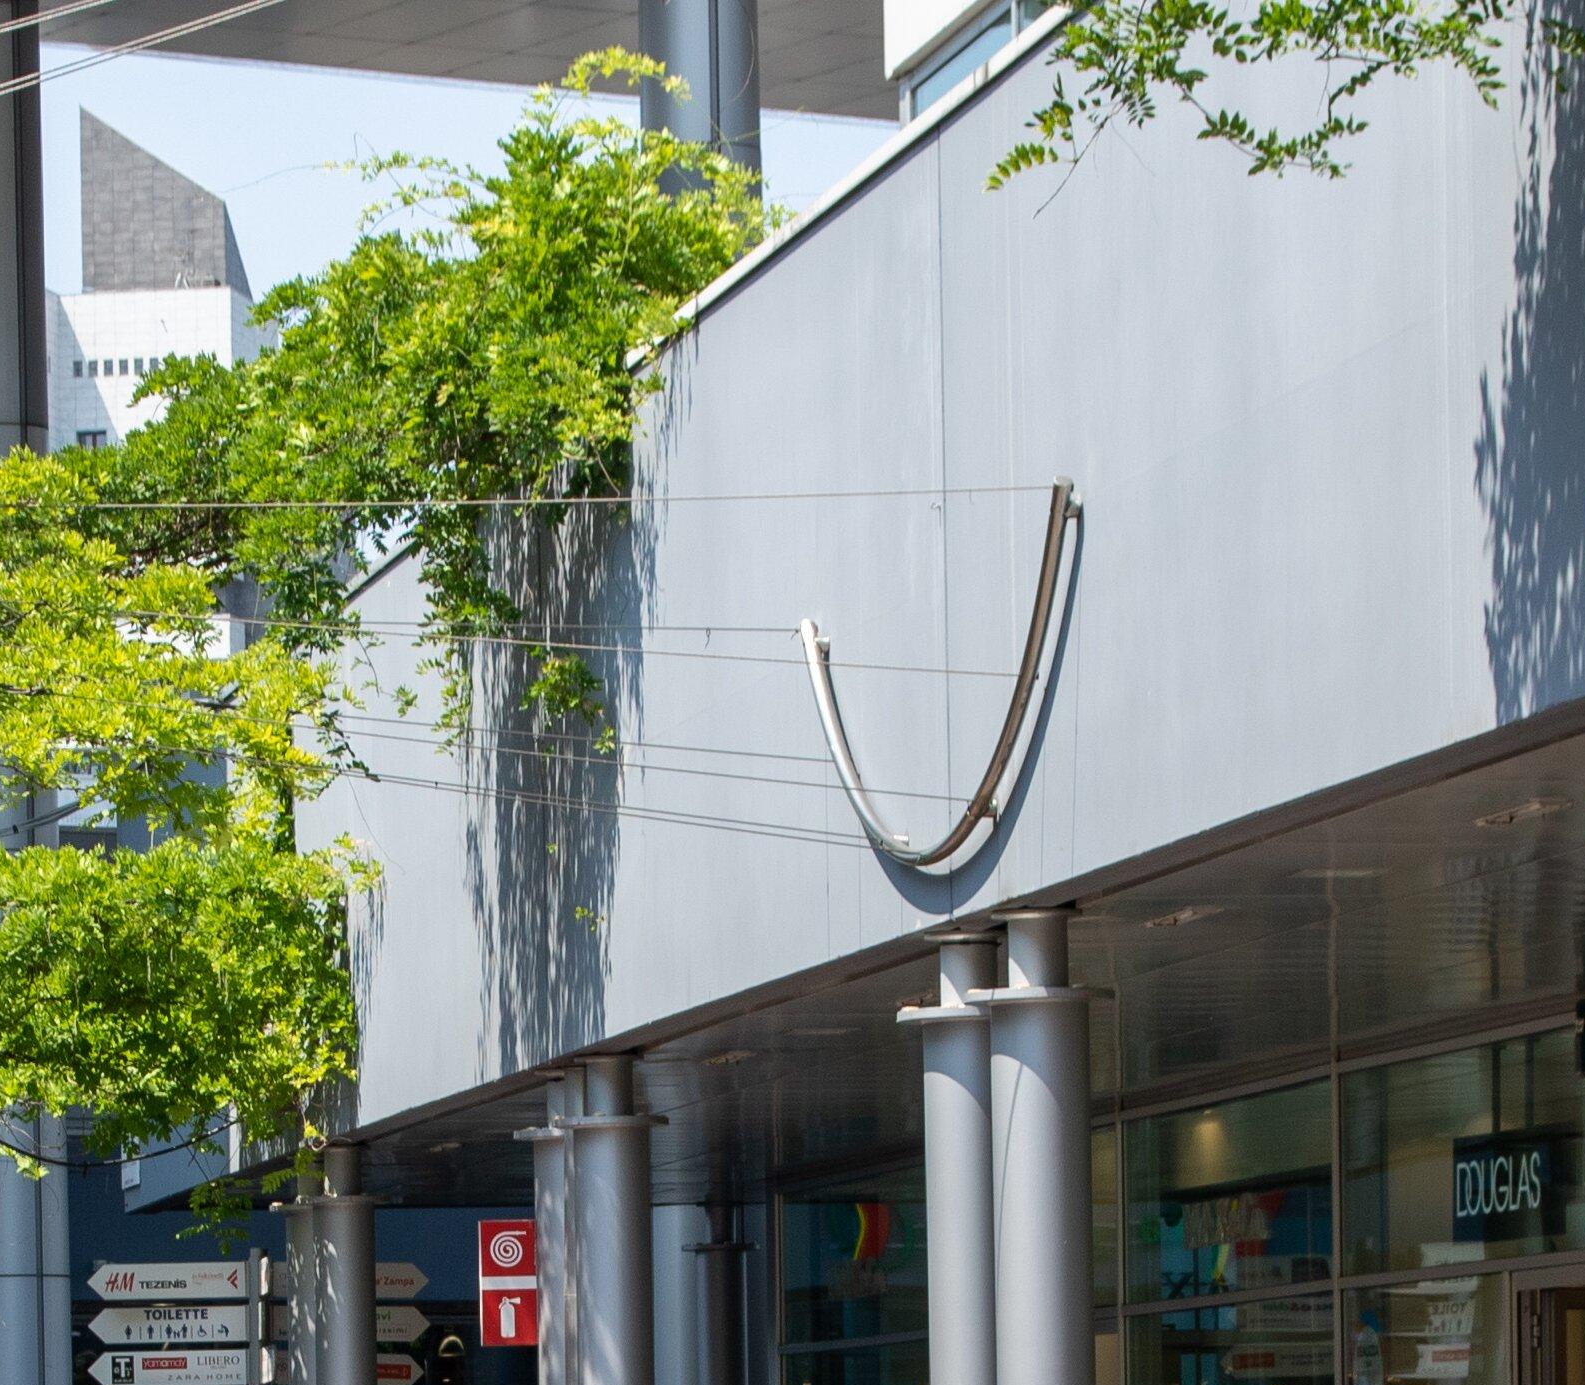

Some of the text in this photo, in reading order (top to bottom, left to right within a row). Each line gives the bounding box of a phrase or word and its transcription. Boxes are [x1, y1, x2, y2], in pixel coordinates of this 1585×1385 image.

[1456, 1151, 1541, 1217] DOUGLAS
[144, 1308, 209, 1320] TOILETTE
[196, 1355, 240, 1366] LIBERO
[167, 1373, 201, 1381] ZARA
